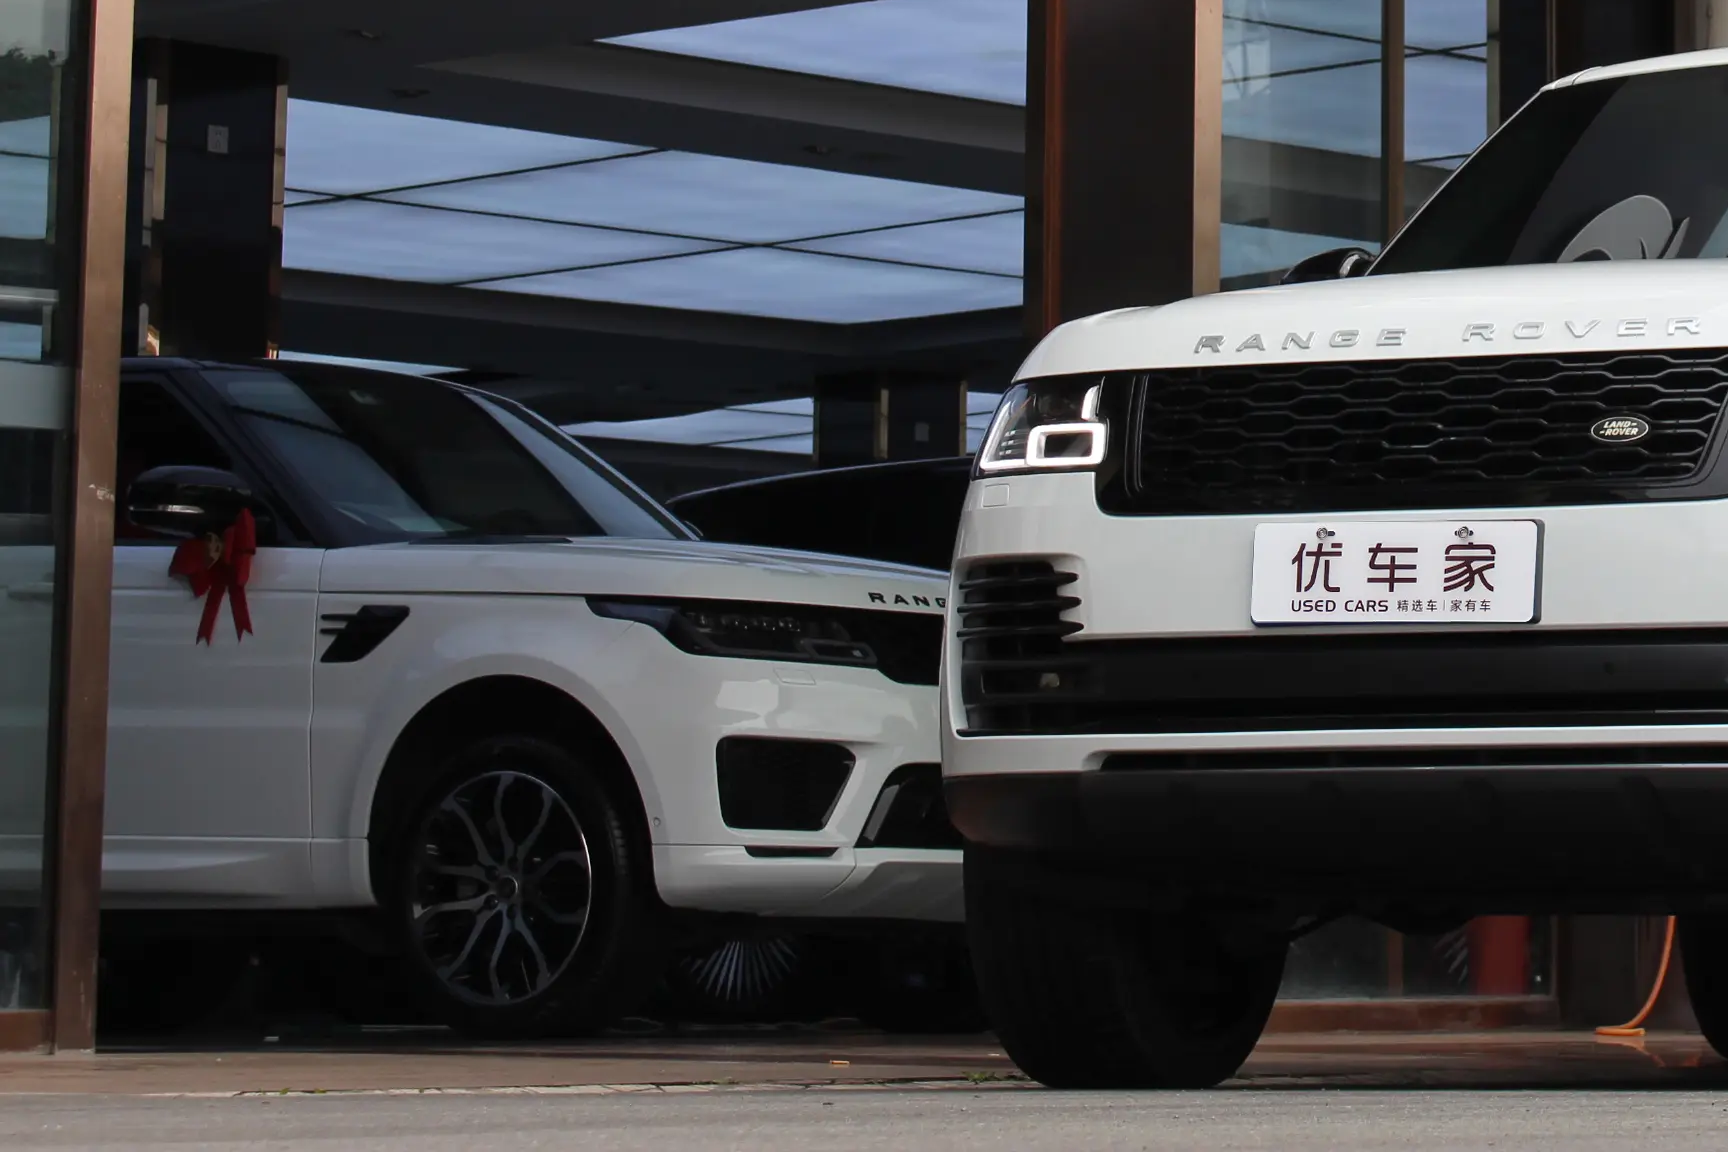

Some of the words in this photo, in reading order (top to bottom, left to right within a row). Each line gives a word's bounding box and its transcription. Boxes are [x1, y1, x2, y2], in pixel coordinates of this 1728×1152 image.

[1193, 326, 1409, 354] RANGE
[1462, 316, 1702, 343] ROVER
[1291, 542, 1497, 593] 优车家
[1291, 600, 1337, 613] USED
[1344, 600, 1389, 613] CARS
[1397, 599, 1438, 612] 精选车
[1450, 599, 1491, 612] 家有车
